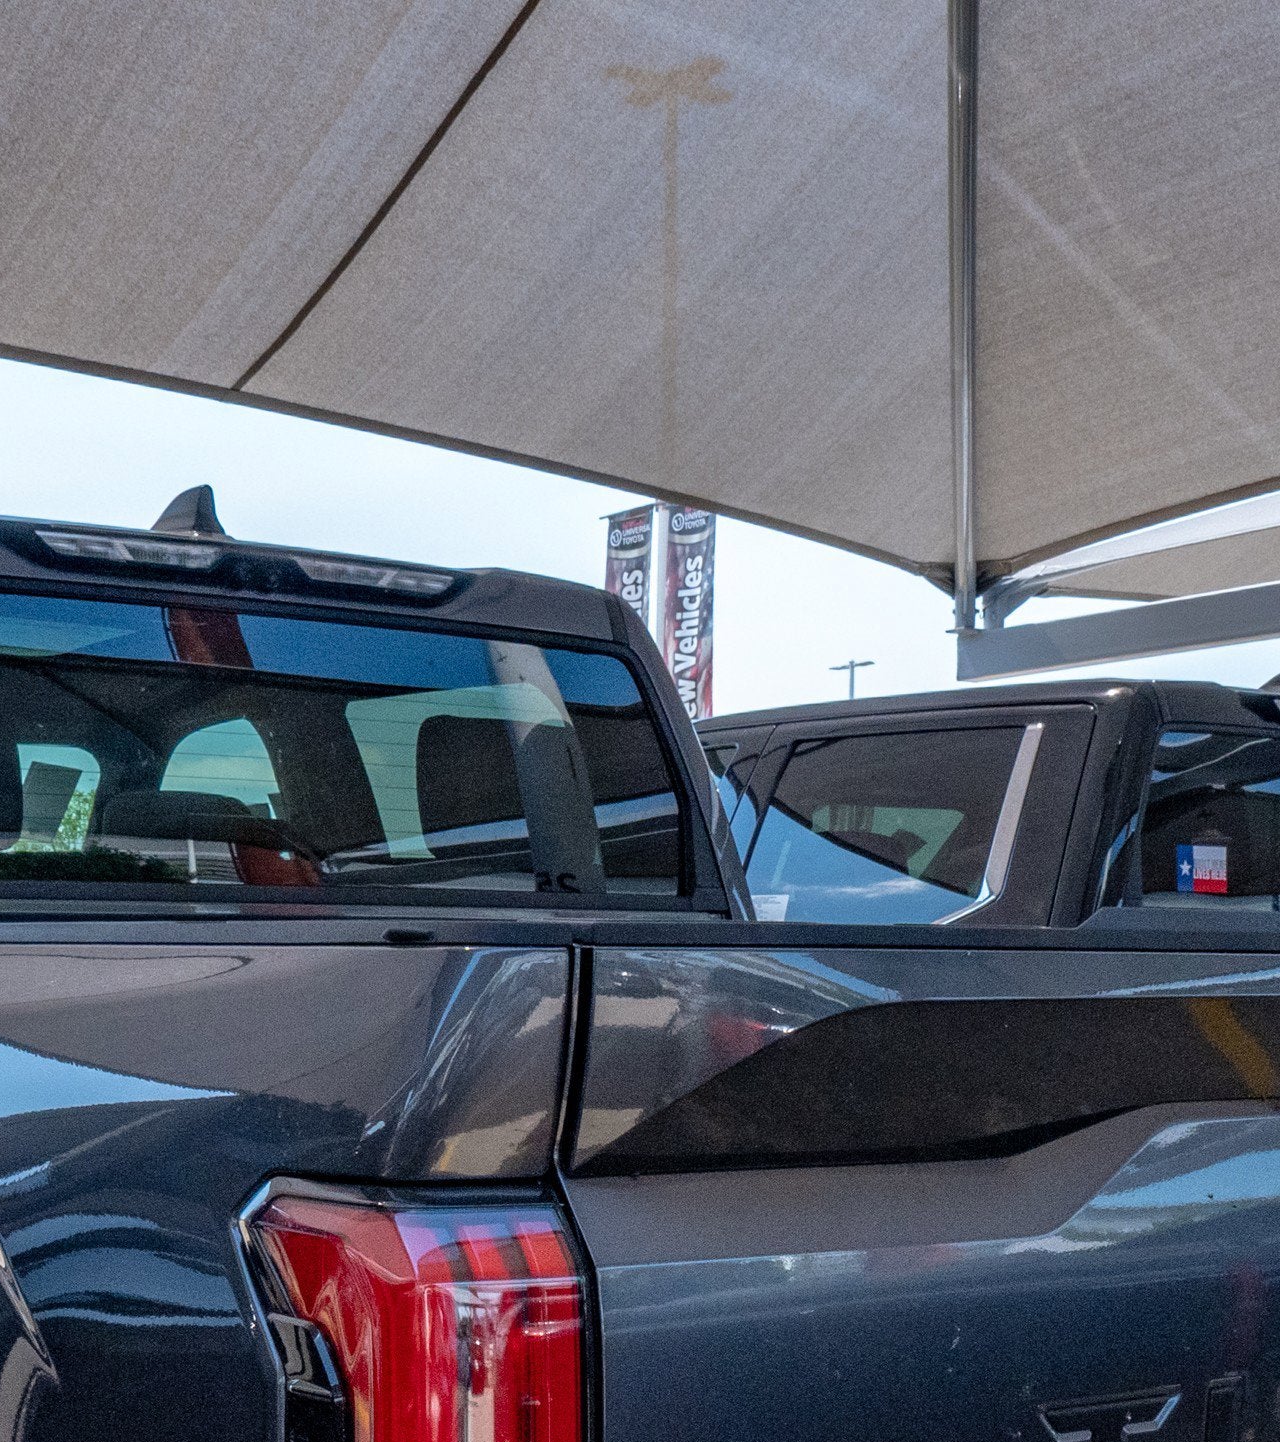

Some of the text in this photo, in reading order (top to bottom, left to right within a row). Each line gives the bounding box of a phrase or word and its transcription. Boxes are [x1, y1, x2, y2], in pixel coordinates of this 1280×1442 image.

[684, 518, 706, 530] TOYOTA
[622, 533, 645, 546] TOYOTA
[673, 554, 703, 719] ew Vehicles
